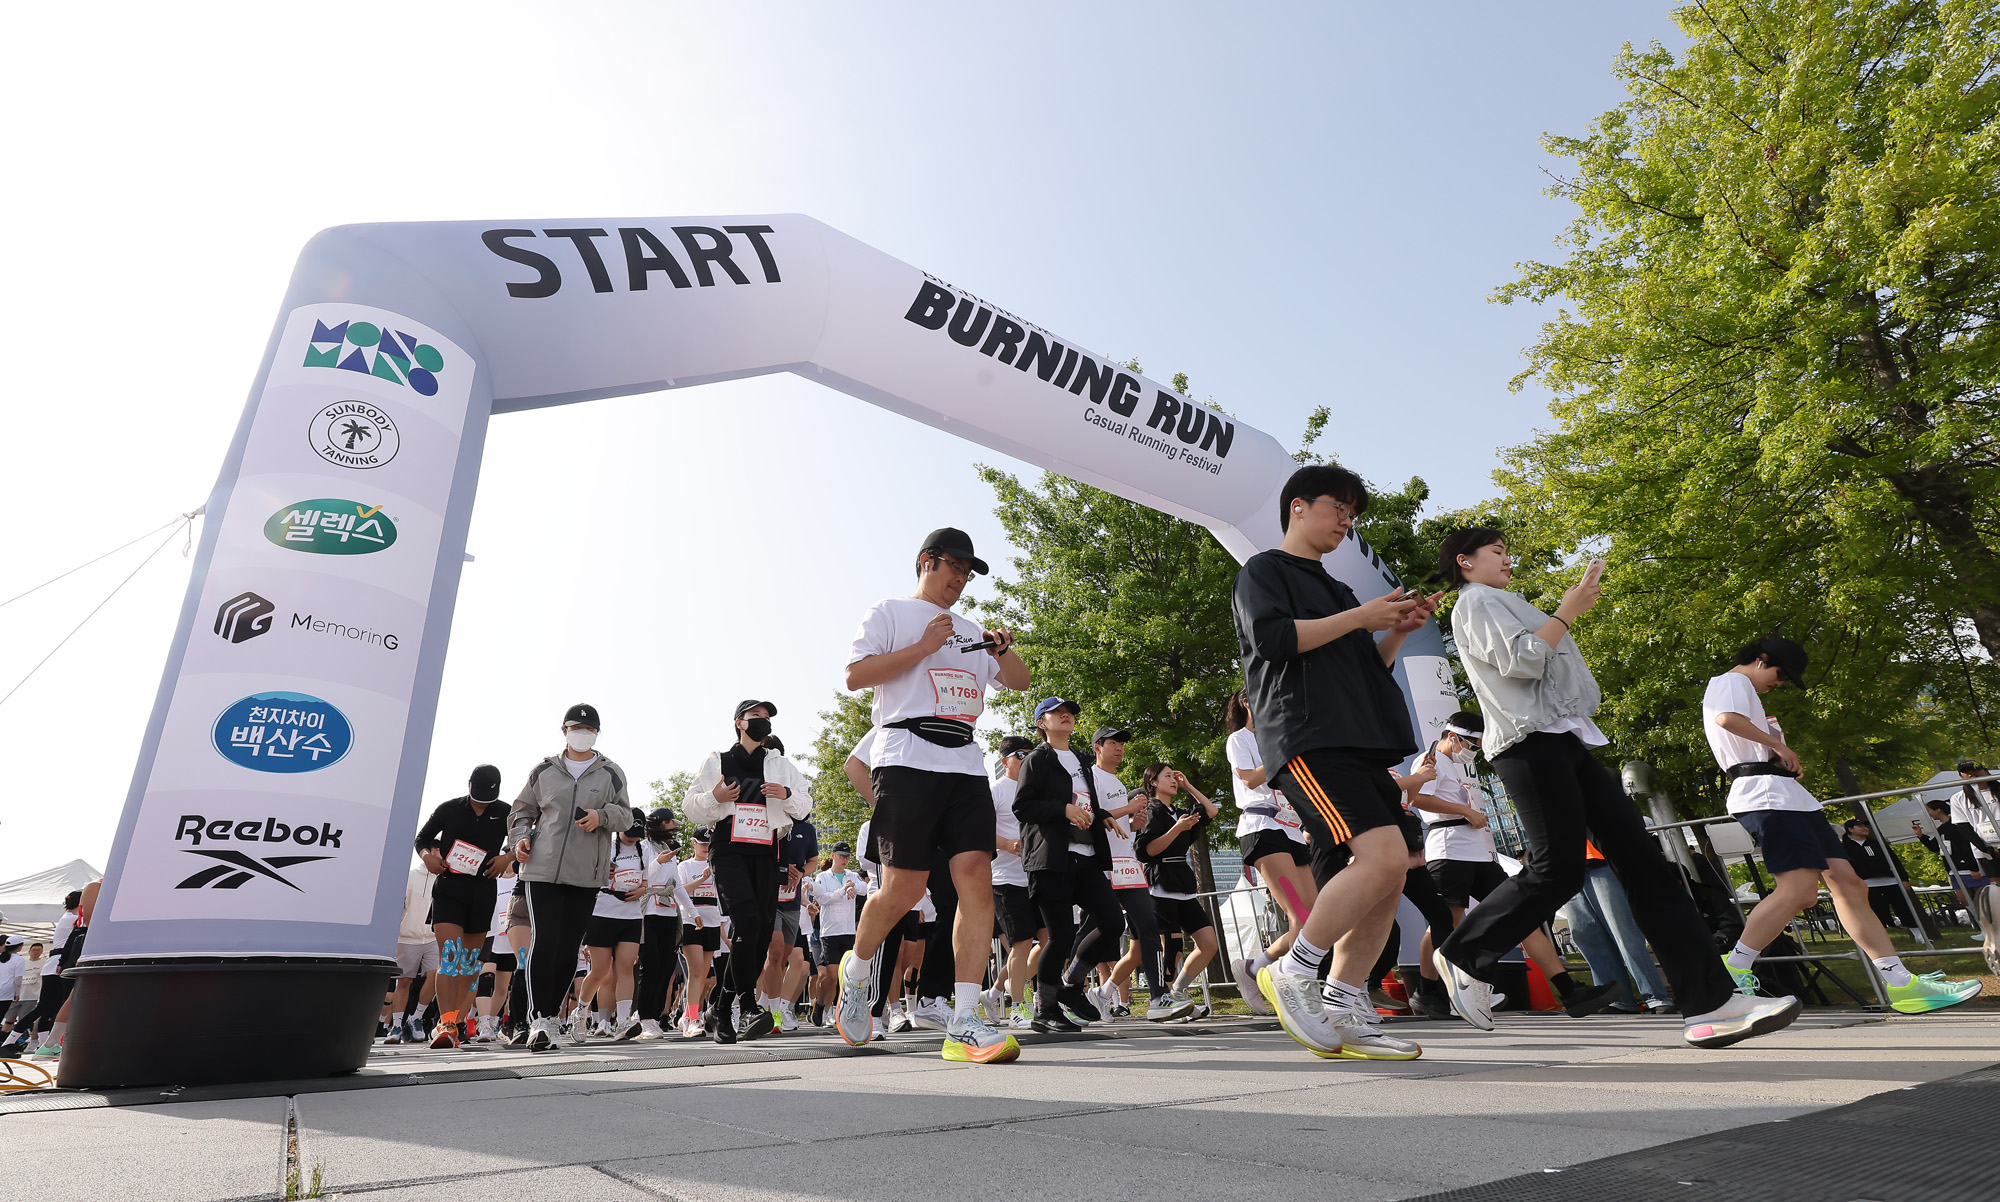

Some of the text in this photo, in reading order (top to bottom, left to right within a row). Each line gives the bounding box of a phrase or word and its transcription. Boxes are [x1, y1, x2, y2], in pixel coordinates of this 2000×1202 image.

[480, 224, 782, 299] START
[903, 279, 1235, 459] BURNING RUN
[325, 403, 393, 432] SUNBODY
[321, 445, 379, 465] TANNING
[1083, 407, 1223, 476] Casual Running Festival
[280, 508, 385, 544] 셀렉스
[290, 612, 399, 651] MemorinG
[949, 686, 978, 700] 1769
[248, 705, 325, 730] 천지차이
[230, 725, 332, 761] 백산수
[174, 814, 344, 849] Reebok
[456, 853, 480, 867] 2141
[1120, 867, 1139, 875] 1061
